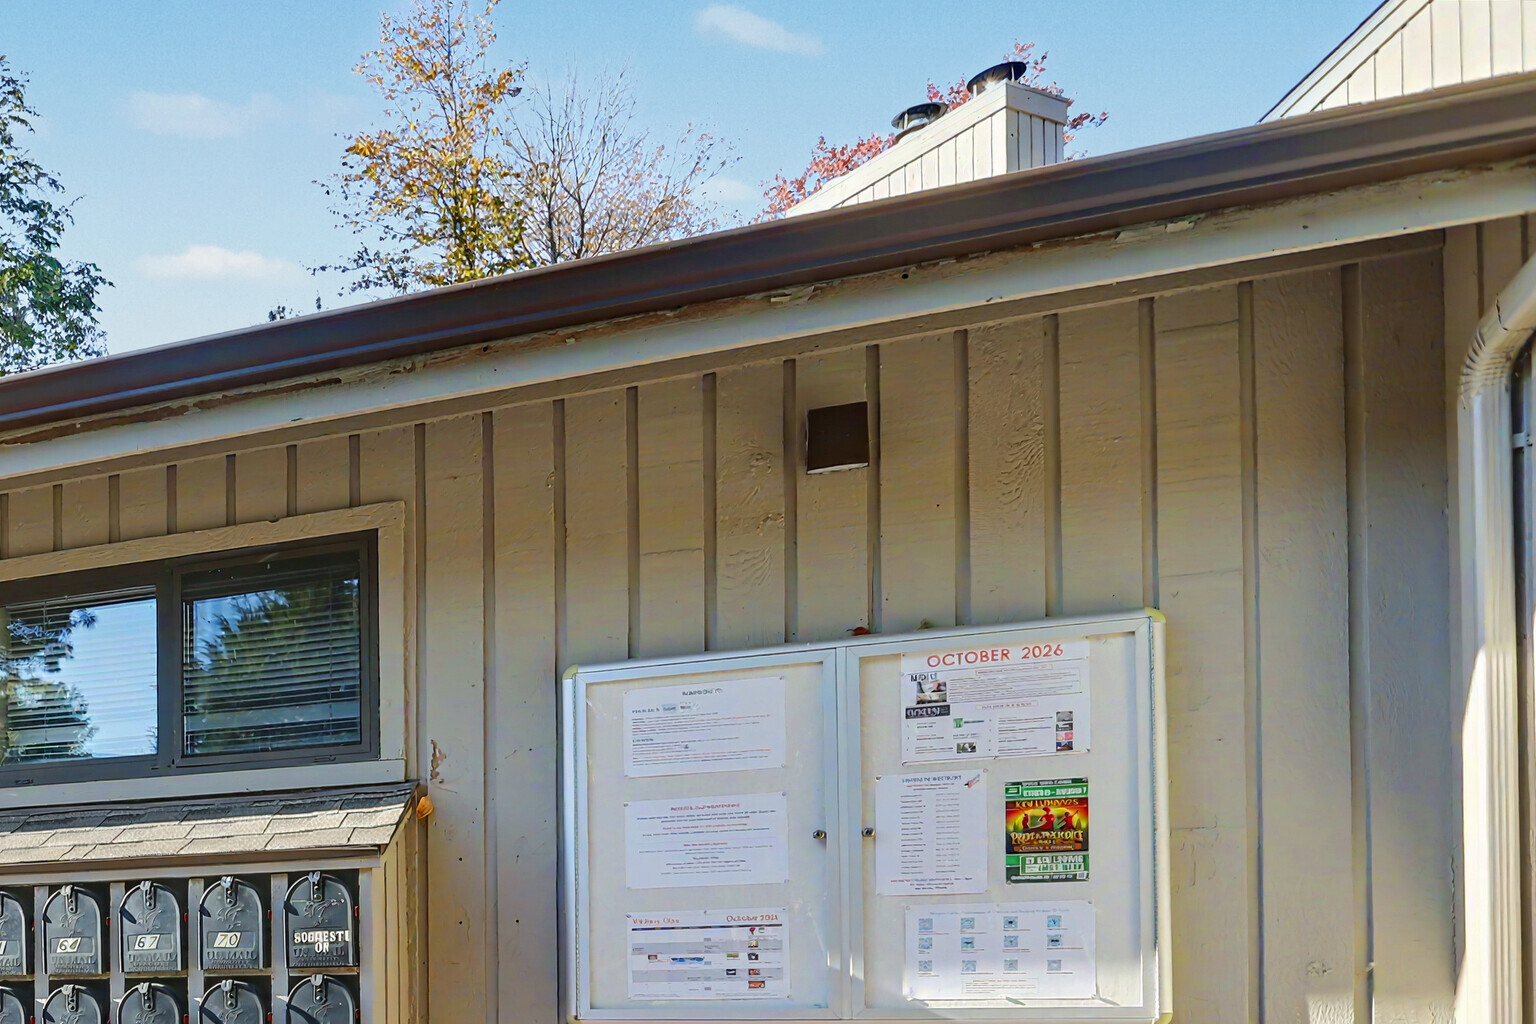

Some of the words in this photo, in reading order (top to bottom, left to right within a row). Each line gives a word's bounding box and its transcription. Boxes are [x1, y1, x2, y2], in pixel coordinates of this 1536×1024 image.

[926, 648, 1010, 668] OCTOBER
[1021, 643, 1064, 660] 2026
[59, 939, 79, 951] 64
[137, 936, 158, 948] 67
[217, 933, 239, 946] 70
